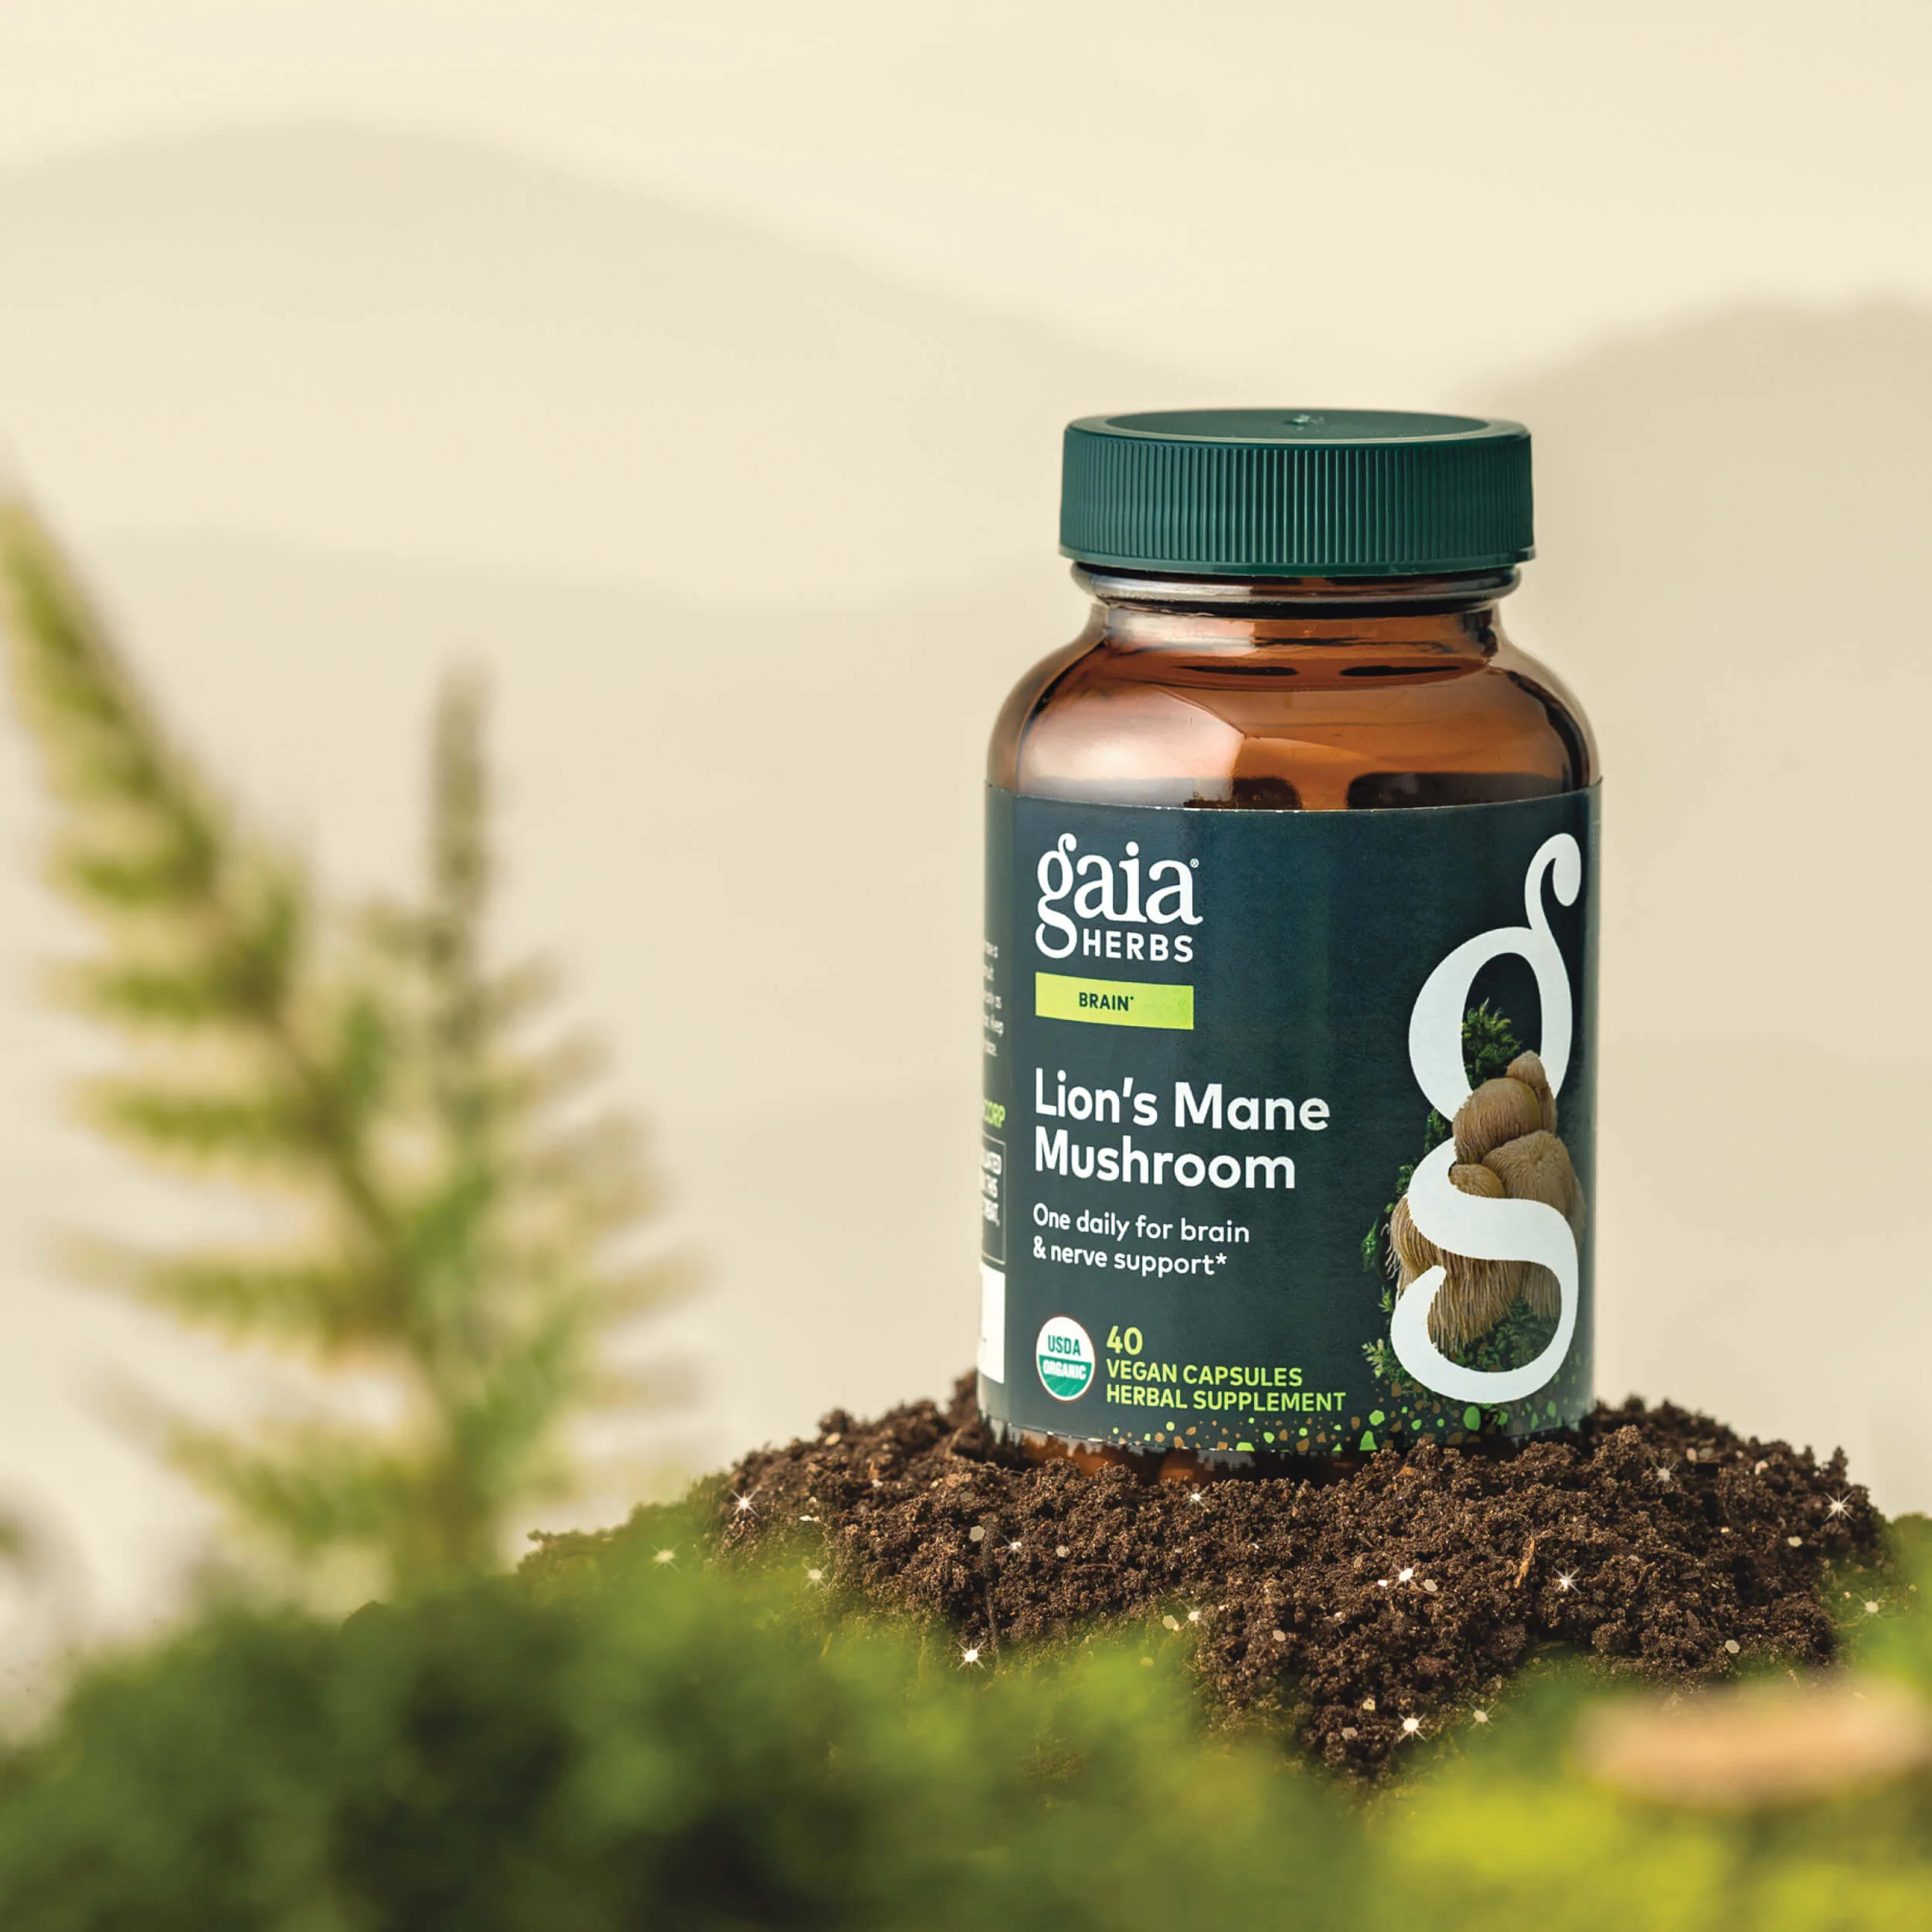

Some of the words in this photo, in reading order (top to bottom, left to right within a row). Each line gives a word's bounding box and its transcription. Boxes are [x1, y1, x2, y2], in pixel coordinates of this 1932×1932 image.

[1083, 928, 1194, 963] HERBS
[1036, 1067, 1158, 1127] Lion's
[1175, 1081, 1331, 1131] Mane
[1035, 1125, 1296, 1189] Mushroom
[1032, 1202, 1071, 1230] One
[1077, 1209, 1130, 1242] daily
[1135, 1215, 1173, 1240] for
[1181, 1218, 1250, 1243] brain
[1032, 1235, 1047, 1260] &
[1050, 1243, 1108, 1268] nerve
[1047, 1335, 1082, 1357] USDA
[1106, 1325, 1144, 1356] 40
[1043, 1359, 1087, 1381] ORGANIC
[1106, 1359, 1178, 1384] VEGAN
[1182, 1365, 1303, 1388] CAPSULES
[1106, 1383, 1188, 1410] HERBAL
[1192, 1389, 1347, 1413] SUPPLEMENT
